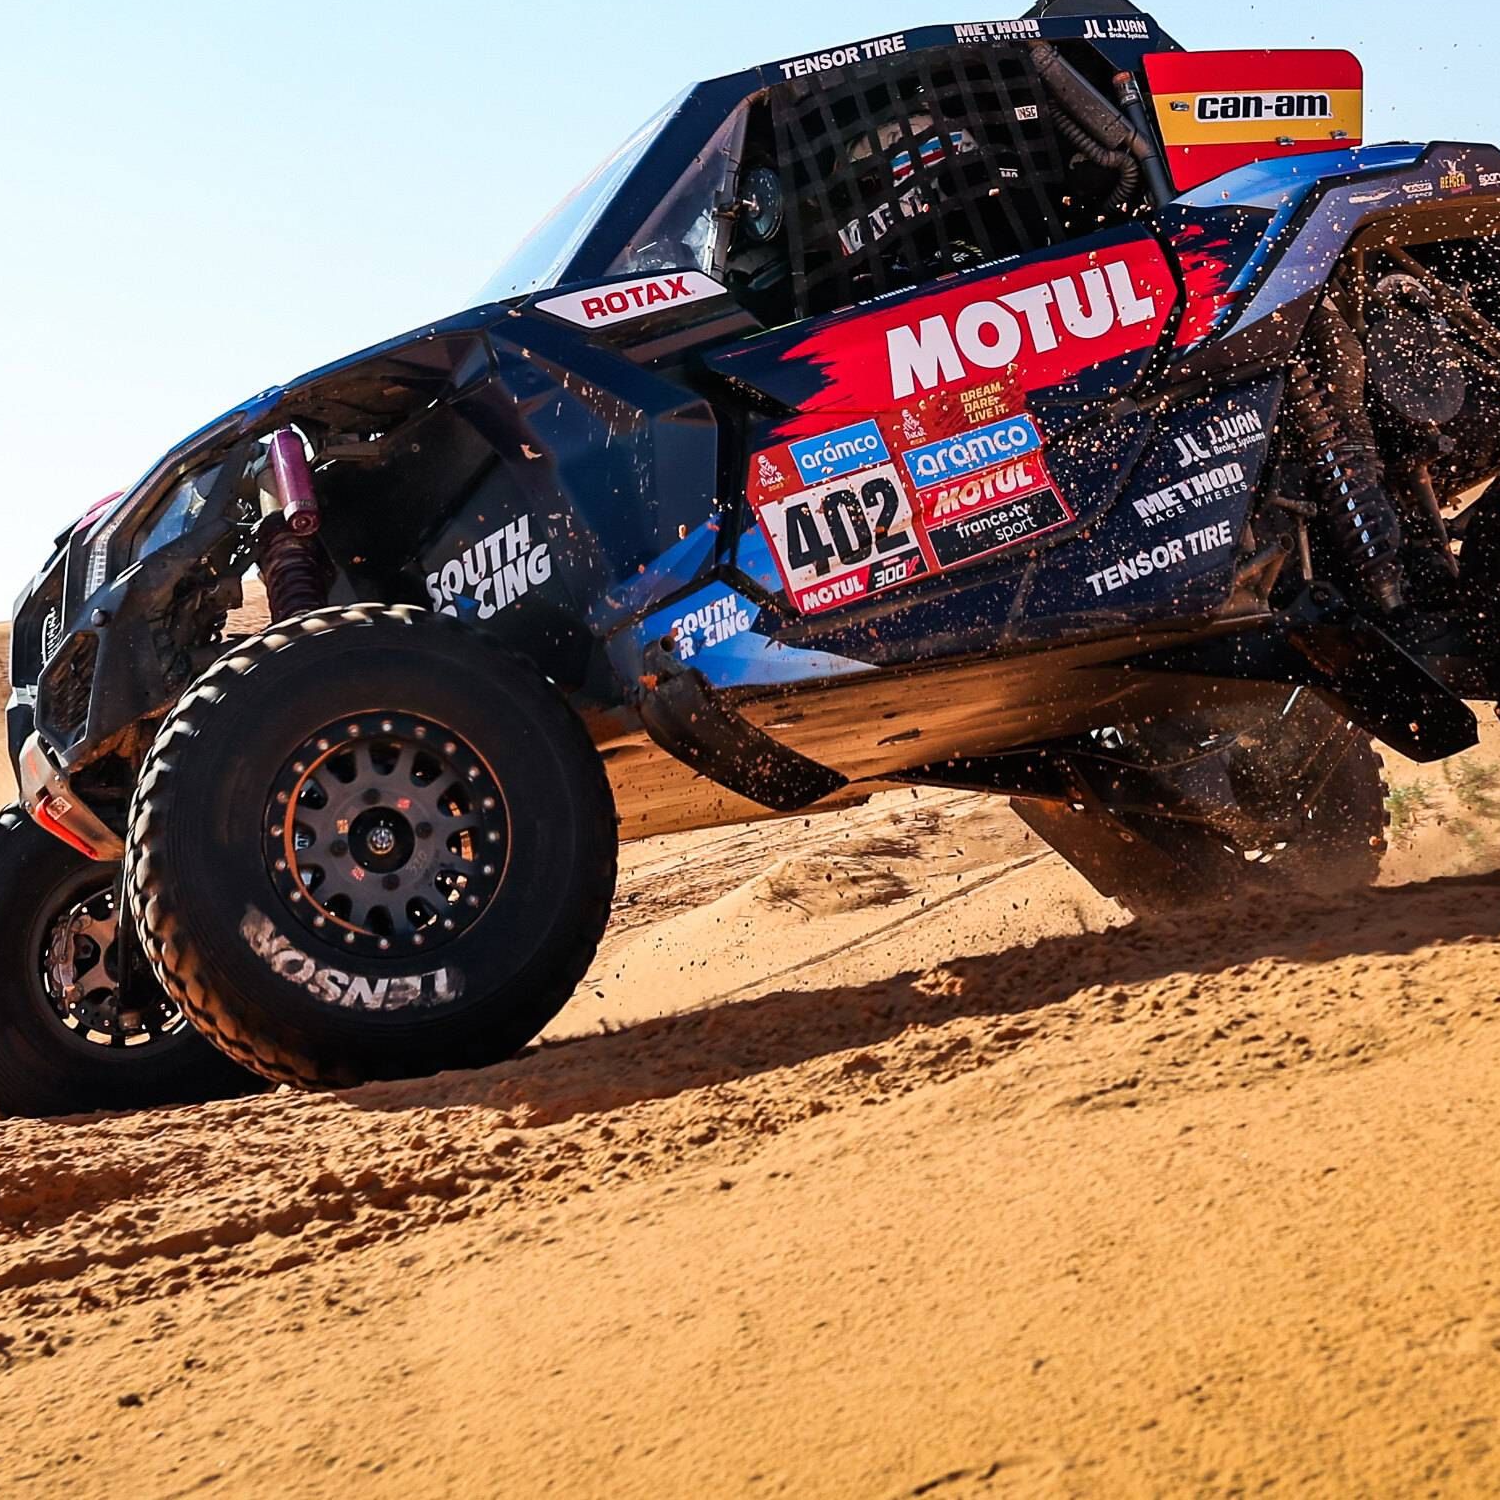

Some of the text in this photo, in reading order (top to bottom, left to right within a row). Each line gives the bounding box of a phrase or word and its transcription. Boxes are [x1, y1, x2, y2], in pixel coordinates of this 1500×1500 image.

[954, 19, 1040, 38] METHOD
[957, 31, 1042, 45] RACE WHEELS
[1107, 20, 1148, 34] J.JUAN
[780, 34, 907, 80] TENSOR TIRE
[1197, 93, 1329, 120] can-am
[581, 275, 692, 320] ROTAX
[886, 260, 1156, 400] MOTUL
[960, 381, 1004, 403] DREAM.
[968, 407, 994, 425] LIVE
[1206, 408, 1263, 445] J.JUAN
[801, 434, 878, 469] aramco
[917, 425, 1028, 476] aramco
[1237, 431, 1266, 449] Systems
[933, 460, 1034, 518] MOTUL
[1132, 462, 1245, 520] METHOD
[1143, 480, 1248, 528] RACE WHEELS
[785, 477, 910, 577] 402
[995, 514, 1038, 543] sport
[426, 513, 531, 613] SOUTH
[1085, 519, 1233, 597] TENSOR TIRE
[440, 542, 552, 620] CING
[802, 575, 865, 611] MOTUL
[671, 593, 738, 642] SOUTH
